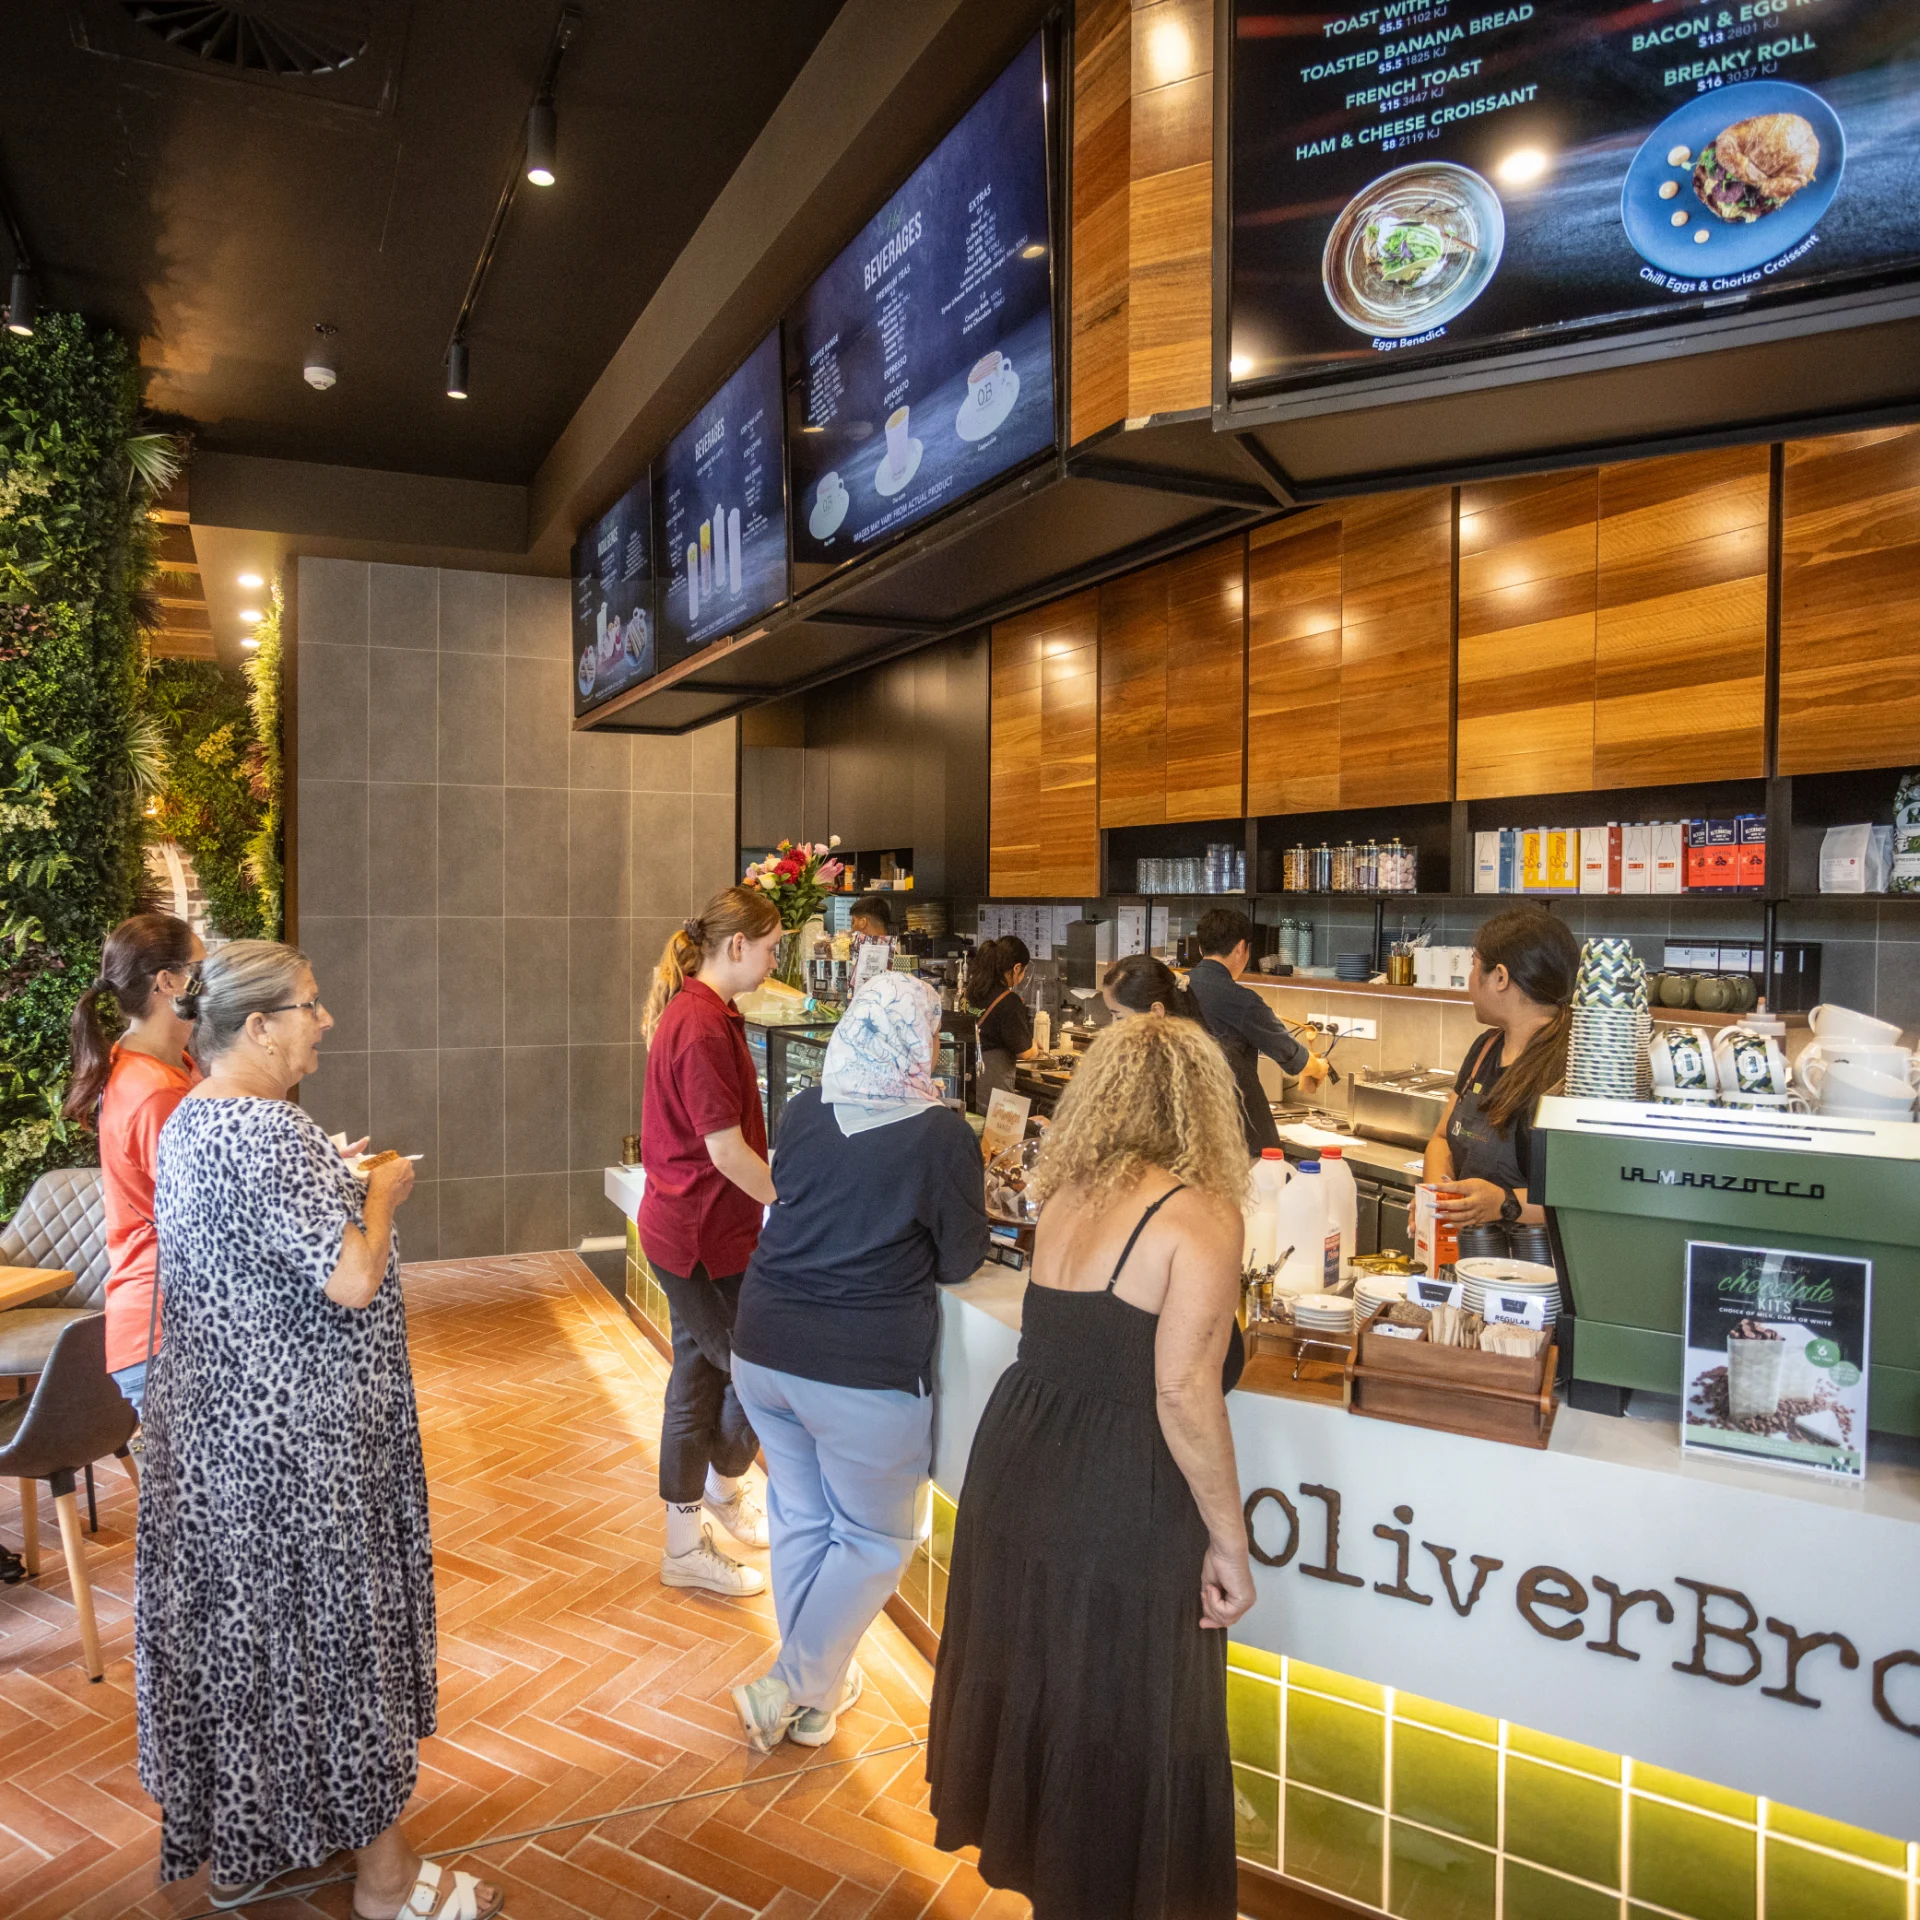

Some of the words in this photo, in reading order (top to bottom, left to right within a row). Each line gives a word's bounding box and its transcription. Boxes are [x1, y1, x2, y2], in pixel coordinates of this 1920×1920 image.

[1323, 8, 1380, 38] TOAST
[1384, 0, 1430, 20] WITH
[1378, 19, 1402, 35] $5.5
[1406, 11, 1431, 27] 1102
[1433, 5, 1447, 18] KJ
[1631, 16, 1710, 52] BACON
[1717, 11, 1732, 28] &
[1740, 0, 1788, 22] EGG
[1698, 32, 1724, 48] $13
[1727, 23, 1758, 41] 2801
[1762, 16, 1779, 29] KJ
[1300, 50, 1379, 83] TOASTED
[1384, 25, 1464, 60] BANANA
[1469, 4, 1534, 36] BREAD
[1663, 49, 1752, 87] BREAKY
[1757, 32, 1817, 63] ROLL
[1378, 58, 1402, 74] $5.5
[1405, 52, 1430, 67] 1825
[1433, 46, 1447, 58] KJ
[1346, 78, 1416, 109] FRENCH
[1421, 59, 1482, 88] TOAST
[1696, 77, 1722, 93] $16
[1726, 67, 1757, 84] 3037
[1761, 62, 1778, 75] KJ
[1379, 99, 1400, 113] $15
[1402, 92, 1427, 107] 3447
[1431, 87, 1444, 99] KJ
[1296, 138, 1336, 161] HAM
[1340, 133, 1353, 149] &
[1358, 114, 1426, 144] CHEESE
[1431, 84, 1538, 126] CROISSANT
[1382, 138, 1396, 151] $8
[1398, 132, 1424, 147] 2119
[1427, 127, 1440, 139] KJ
[968, 183, 991, 213] EXTRAS
[864, 210, 922, 292] BEVERAGES
[1640, 267, 1666, 286] Chilli
[1666, 278, 1696, 294] Eggs
[1698, 279, 1708, 292] &
[1712, 271, 1761, 290] Chorizo
[1763, 233, 1820, 275] Croissant
[876, 275, 898, 303] PREMIUM
[898, 263, 911, 282] TEAS
[1372, 338, 1397, 351] Eggs
[1399, 326, 1446, 348] Benedict
[883, 354, 907, 381] ESPRESSO
[883, 378, 909, 407] AFFOGATO
[852, 525, 870, 543] IMAGES
[870, 520, 880, 533] MAY
[880, 511, 893, 526] VARY
[893, 503, 907, 519] FROM
[908, 492, 928, 510] ACTUAL
[928, 475, 954, 497] PRODUCT
[1620, 1165, 1644, 1182] LA
[1658, 1169, 1825, 1200] MARZOCCO
[1717, 1269, 1835, 1303] chocolate
[1494, 1314, 1530, 1326] REGULAR
[1718, 1307, 1744, 1316] CHOICE
[1756, 1312, 1776, 1320] MILK,
[1777, 1314, 1797, 1322] DARK
[1809, 1318, 1832, 1327] WHITE
[1757, 1297, 1792, 1314] KITS
